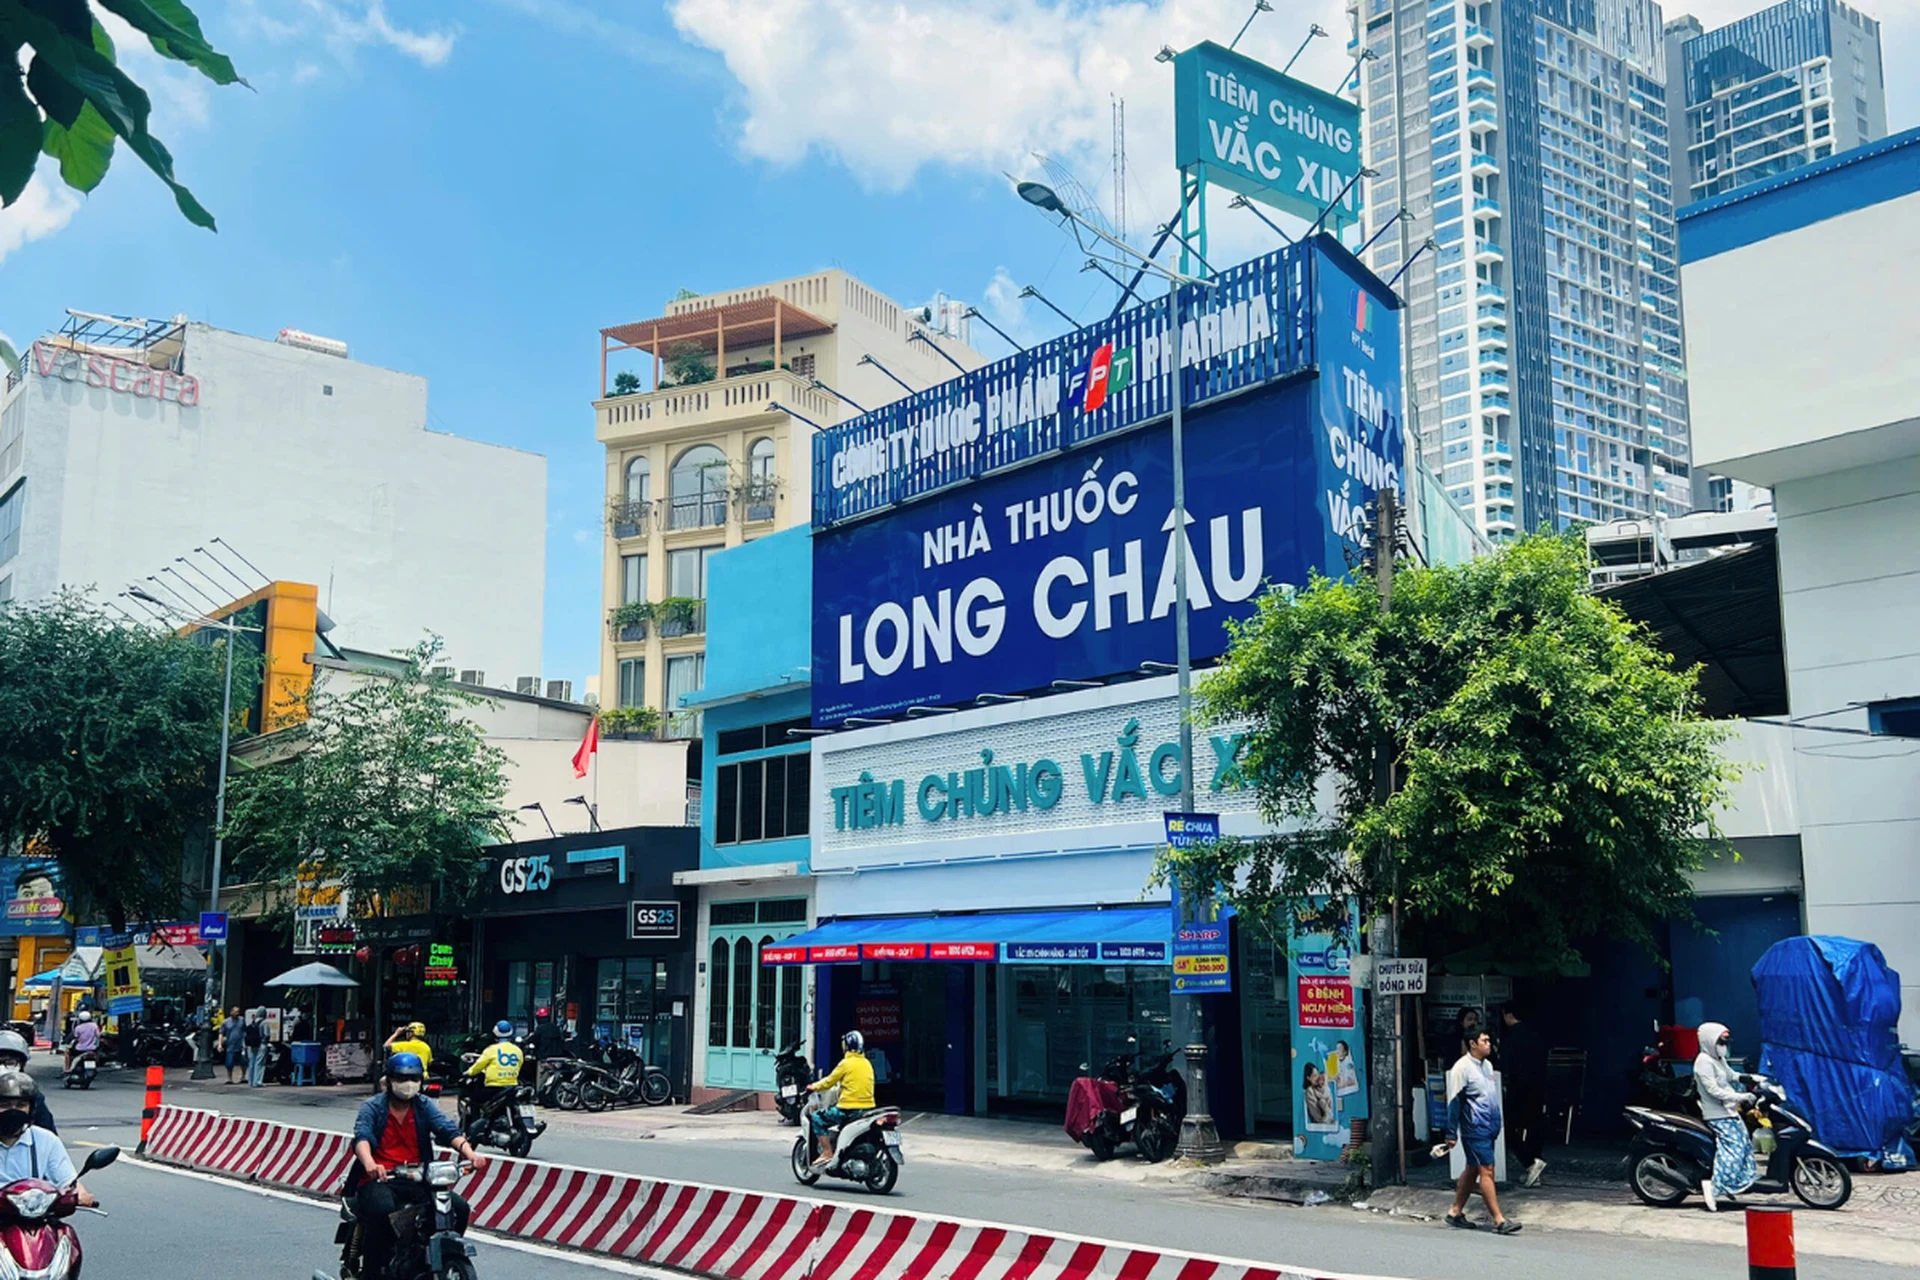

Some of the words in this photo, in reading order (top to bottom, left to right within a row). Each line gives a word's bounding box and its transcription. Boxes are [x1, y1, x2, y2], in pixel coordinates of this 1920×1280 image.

[1206, 70, 1258, 115] TIÊM
[1269, 100, 1352, 153] CHỦNG
[1208, 116, 1281, 180] VẮC
[1296, 156, 1352, 212] XIN
[33, 341, 200, 406] Vascara
[832, 437, 886, 489] CÔNG
[889, 425, 915, 468] TY
[986, 366, 1059, 437] PHẨM
[1067, 353, 1131, 400] FPT
[1142, 293, 1271, 382] PHARMA
[1343, 366, 1383, 430] TIÊM
[1330, 426, 1398, 499] CHỦNG
[923, 502, 992, 568] NHÀ
[1006, 456, 1138, 544] THUỐC
[839, 577, 1006, 684] LONG
[1033, 506, 1264, 639] CHÂU
[831, 770, 905, 829] TIÊM
[917, 749, 1063, 821] CHỦNG
[1080, 718, 1183, 802] VẮC
[501, 855, 550, 894] GS25
[637, 909, 675, 924] GS25
[1179, 929, 1221, 941] SHARP
[1307, 988, 1314, 999] 6
[1316, 986, 1344, 1001] BỆNH
[1379, 960, 1406, 975] CHUYÊN
[1301, 1003, 1326, 1013] NGUY
[497, 1048, 519, 1066] be
